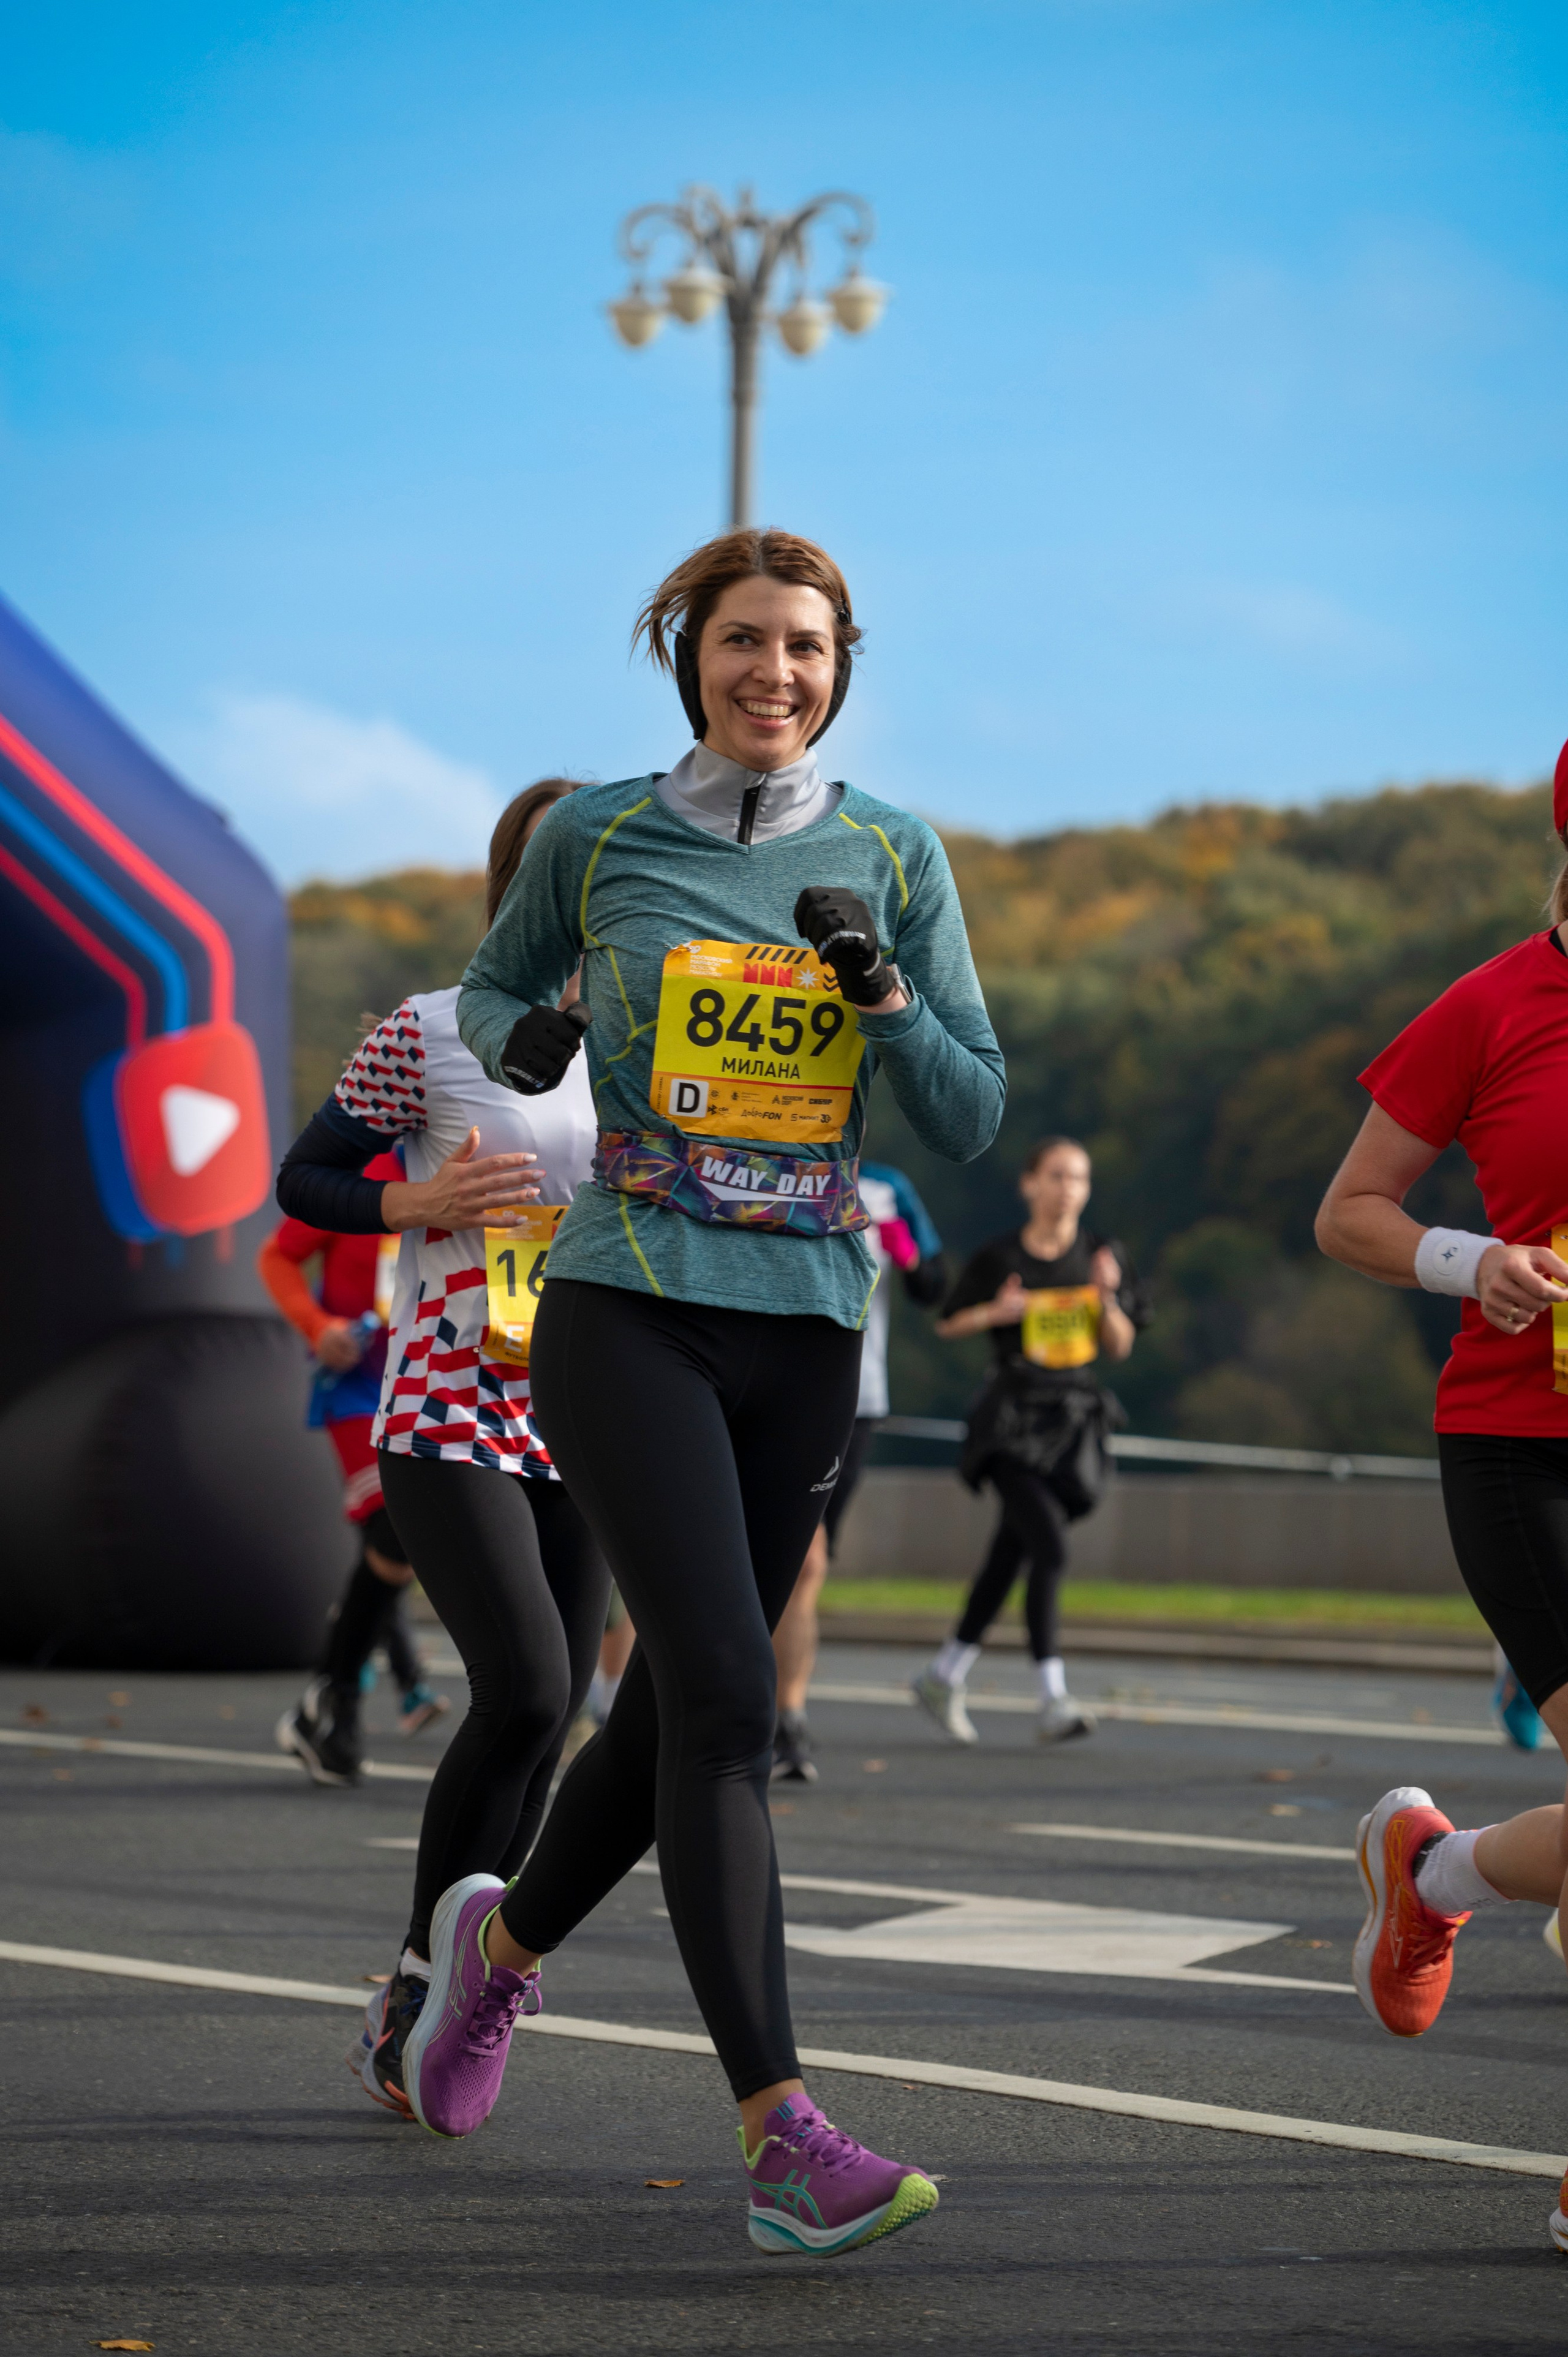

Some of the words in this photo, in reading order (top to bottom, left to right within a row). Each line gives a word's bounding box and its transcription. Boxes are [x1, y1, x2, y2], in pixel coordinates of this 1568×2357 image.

[686, 988, 845, 1057] 8459
[722, 1057, 801, 1079] МИЛАНА
[676, 1082, 700, 1114] D
[701, 1156, 768, 1190] WAY
[776, 1174, 831, 1196] DAY
[497, 1250, 549, 1299] 16
[504, 1326, 524, 1353] E
